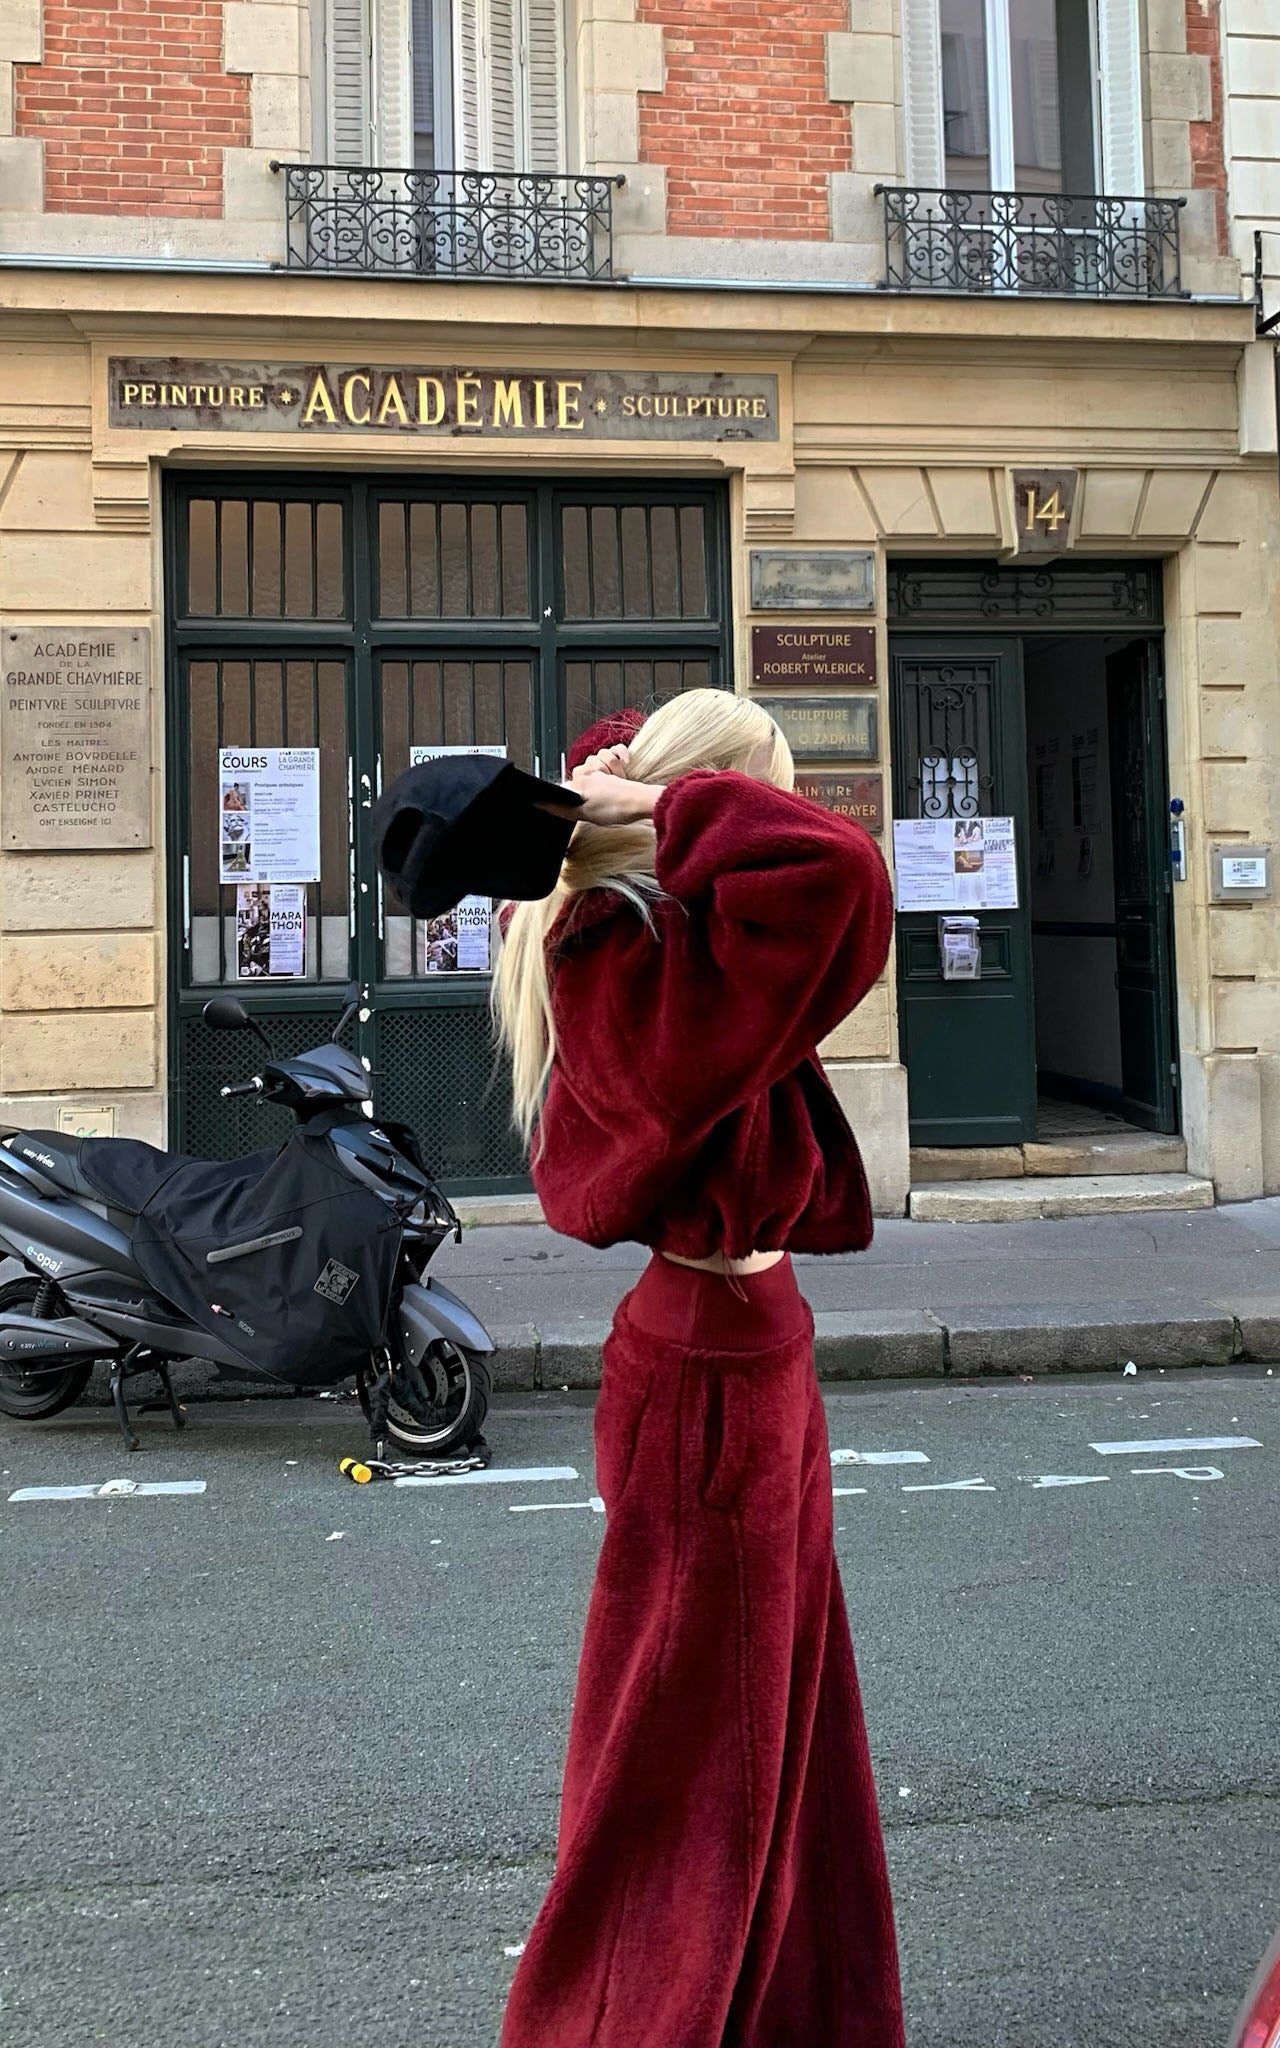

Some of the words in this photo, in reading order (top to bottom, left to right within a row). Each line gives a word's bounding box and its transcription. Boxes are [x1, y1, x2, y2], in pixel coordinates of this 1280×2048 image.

[122, 382, 265, 409] PEINTURE
[302, 368, 584, 431] ACADÉMIE
[621, 394, 767, 421] SCULPTURE
[1025, 489, 1065, 530] 14
[776, 634, 852, 647] SCULPTURE
[33, 642, 117, 657] ACADÉMIE
[801, 652, 827, 661] Atelier
[763, 662, 810, 674] ROBERT
[813, 662, 865, 674] WLERICK
[6, 671, 63, 686] GRANDE
[9, 699, 67, 711] PEINTVRE
[784, 710, 849, 721] SCULPTURE
[74, 720, 87, 729] EN
[89, 720, 113, 729] 1904
[41, 739, 61, 747] LES
[12, 752, 61, 762] ANTOINE
[66, 751, 137, 761] BOVRDELLE
[222, 756, 268, 769] COURS
[33, 778, 72, 787] LVCIEN
[77, 777, 116, 787] SIMON
[29, 791, 70, 800] XAVIER
[75, 790, 120, 800] PRINET
[33, 802, 116, 813] CASTELUCHO
[39, 818, 56, 827] ONT
[101, 817, 111, 826] ICI
[271, 911, 302, 920] MARA
[458, 907, 487, 916] MARA
[271, 921, 302, 930] THON
[458, 916, 488, 926] THON
[26, 1244, 63, 1274] e-opai
